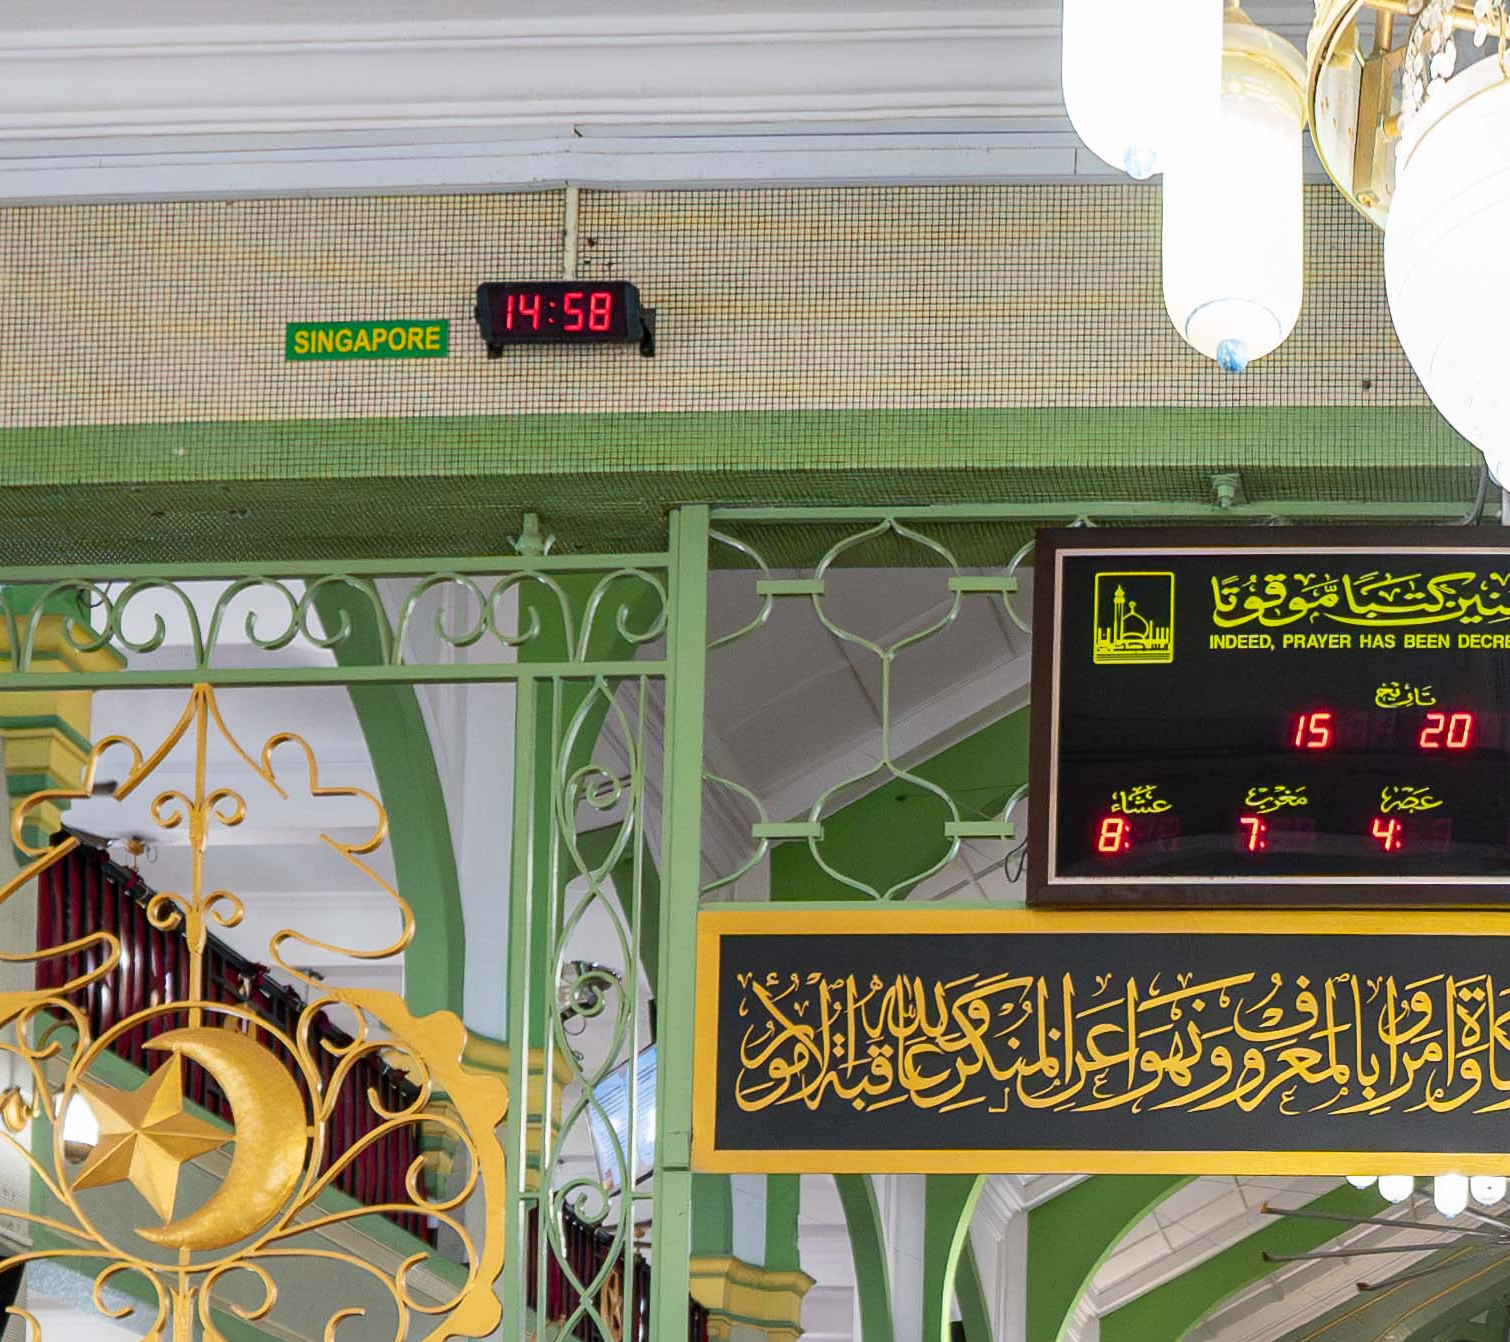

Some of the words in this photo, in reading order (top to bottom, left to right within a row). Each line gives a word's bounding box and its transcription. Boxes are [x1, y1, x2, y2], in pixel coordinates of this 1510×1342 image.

[506, 292, 612, 332] 14:58
[293, 326, 441, 355] SINGAPORE
[1209, 634, 1275, 651] INDEED,
[1282, 633, 1352, 649] PRAYER
[1359, 633, 1396, 649] HAS
[1403, 633, 1451, 649] BEEN
[1294, 712, 1333, 749] 15
[1418, 712, 1473, 749] 20
